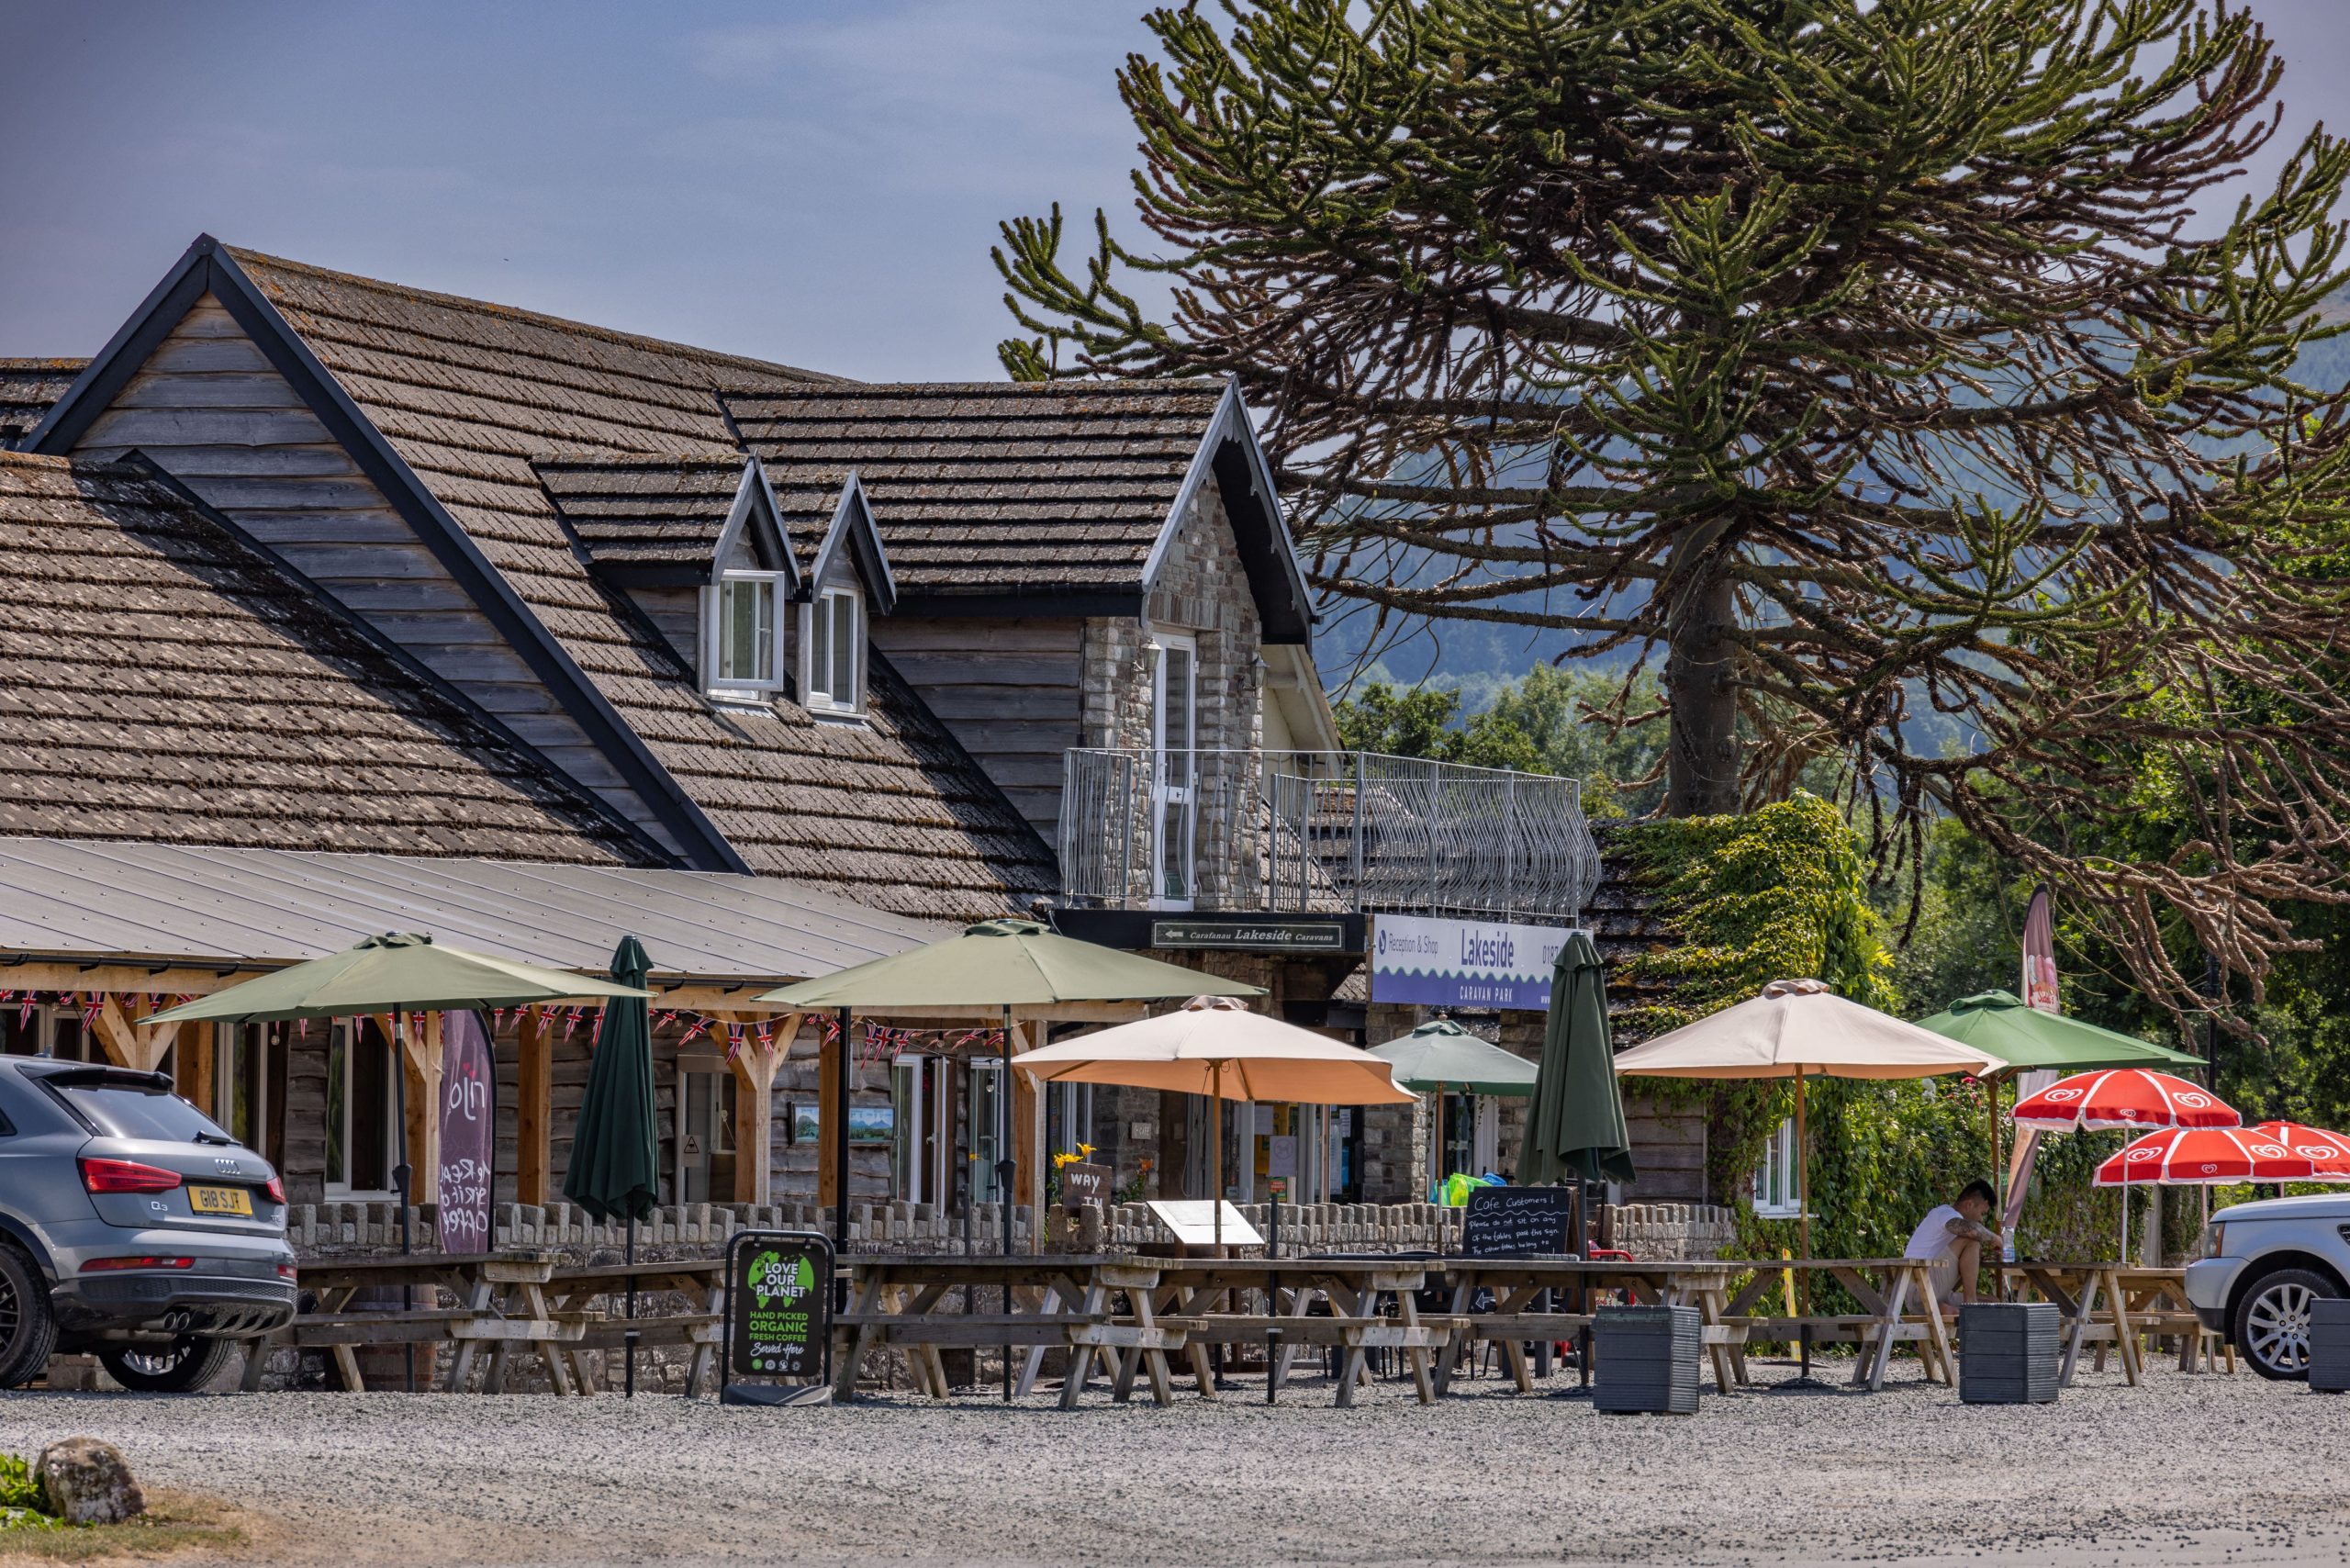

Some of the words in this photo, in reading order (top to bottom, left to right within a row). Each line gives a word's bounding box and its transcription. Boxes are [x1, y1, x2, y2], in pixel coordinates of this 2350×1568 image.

[1234, 929, 1292, 940] Lakeside
[1295, 933, 1334, 941] Caravans
[1388, 934, 1416, 957] Reception
[1416, 935, 1422, 953] &
[1424, 935, 1438, 958] Shop
[1461, 928, 1514, 968] Lakeside
[1460, 986, 1491, 1002] CARAVAN
[1494, 988, 1513, 1002] PARK
[1070, 1173, 1100, 1194] WAY
[151, 1201, 168, 1211] Q3
[220, 1190, 240, 1210] SJT
[1084, 1196, 1102, 1207] IN
[1474, 1196, 1501, 1211] Cafe
[1504, 1217, 1513, 1226] not
[1516, 1216, 1528, 1225] sit
[1530, 1228, 1542, 1237] this
[765, 1262, 799, 1274] LOVE
[767, 1274, 796, 1285] OUR
[756, 1285, 806, 1298] PLANET
[749, 1311, 776, 1319] HAND
[777, 1312, 808, 1320] PICKED
[749, 1320, 808, 1332] ORGANIC
[749, 1333, 775, 1341] FRESH
[776, 1333, 807, 1342] COFFEE
[750, 1342, 781, 1357] Served
[782, 1344, 804, 1360] Here
